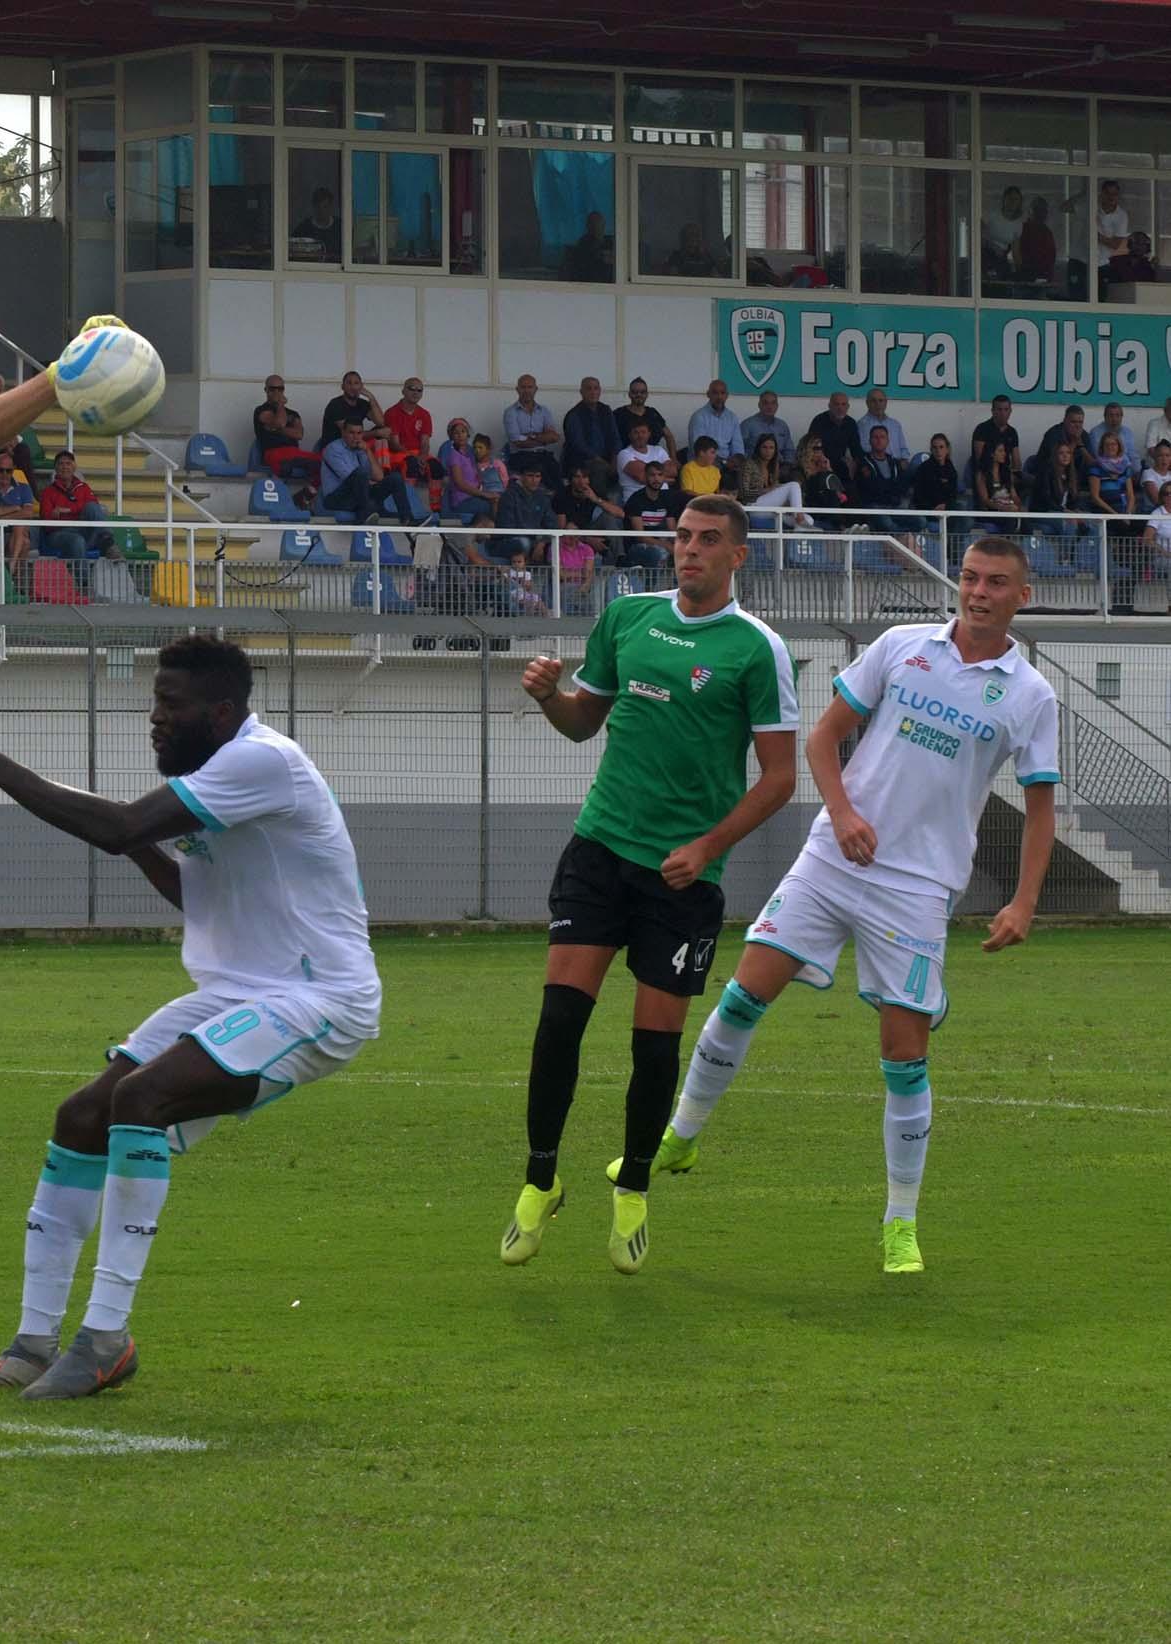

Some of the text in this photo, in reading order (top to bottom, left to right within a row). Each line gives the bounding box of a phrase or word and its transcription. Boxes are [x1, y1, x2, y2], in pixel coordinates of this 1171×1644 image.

[740, 308, 776, 321] OLBIA
[799, 310, 958, 388] Forza
[1001, 317, 1150, 397] Olbia
[648, 627, 697, 649] GIVOVA
[909, 732, 958, 760] GRENDI
[914, 721, 962, 749] GRUPPO
[671, 942, 690, 975] 4
[903, 953, 931, 1004] 4
[205, 1008, 261, 1046] 9
